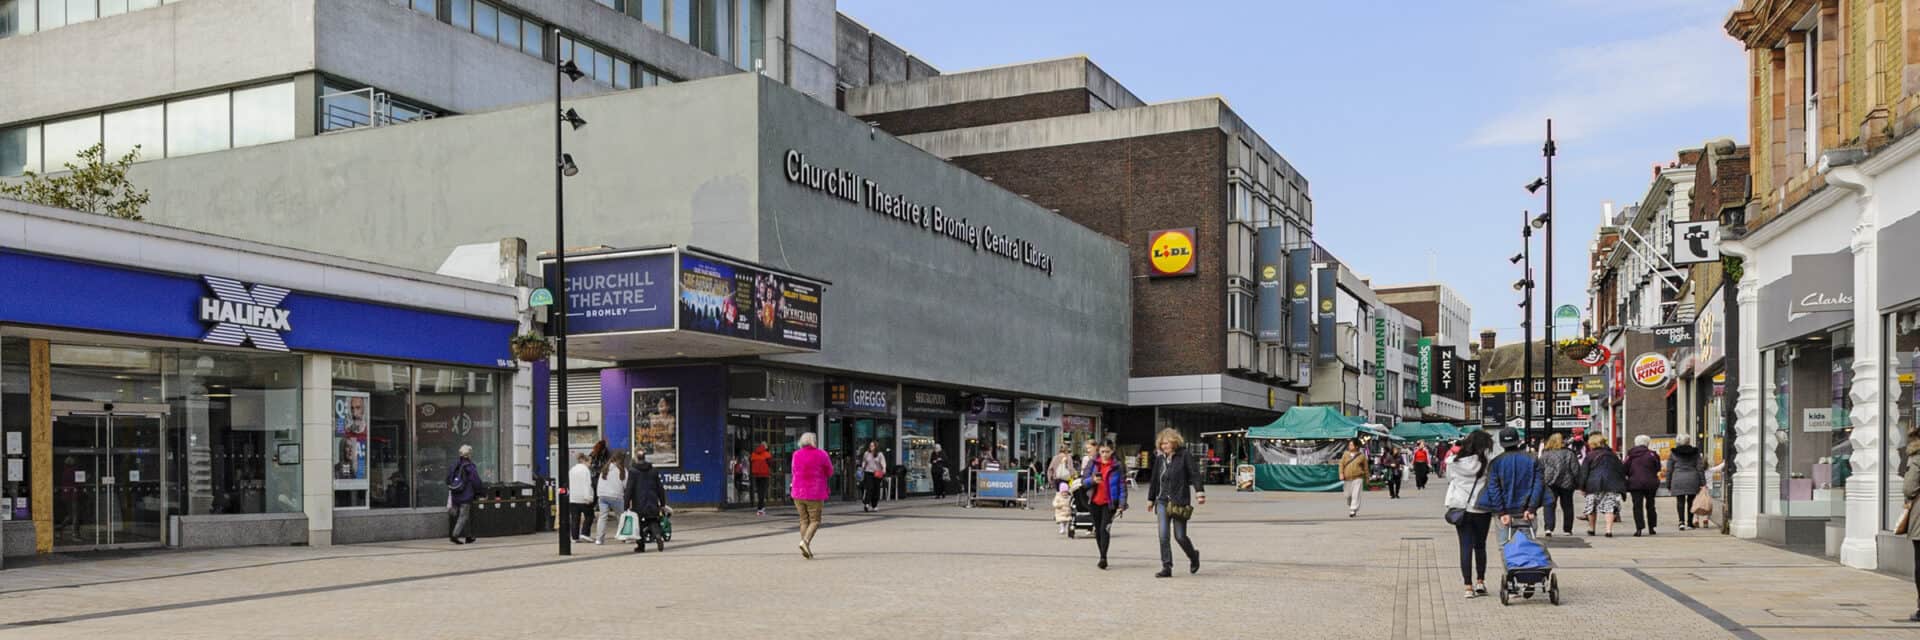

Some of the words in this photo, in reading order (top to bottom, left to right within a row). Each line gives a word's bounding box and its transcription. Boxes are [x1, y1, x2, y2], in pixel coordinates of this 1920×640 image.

[786, 149, 861, 202] Churchill
[866, 179, 920, 225] Theatre
[921, 206, 930, 227] &
[933, 205, 982, 250] Bromley
[983, 224, 1020, 260] Central
[1024, 240, 1055, 275] Library
[570, 288, 644, 309] THEATRE
[1801, 292, 1854, 307] Clarks
[202, 298, 291, 331] HALIFAX
[586, 307, 628, 318] BROMLEY
[1655, 326, 1685, 340] carpet
[1375, 318, 1385, 400] DEICHMANN
[1635, 359, 1665, 373] BURGER
[1419, 345, 1430, 393] Specsavers
[1442, 350, 1452, 389] NEXT
[1637, 365, 1666, 380] KING
[1467, 364, 1476, 398] NEXT
[853, 388, 887, 408] GREGGS
[1808, 411, 1826, 420] kids
[663, 472, 702, 483] THEATRE
[986, 480, 1014, 489] GREGGS
